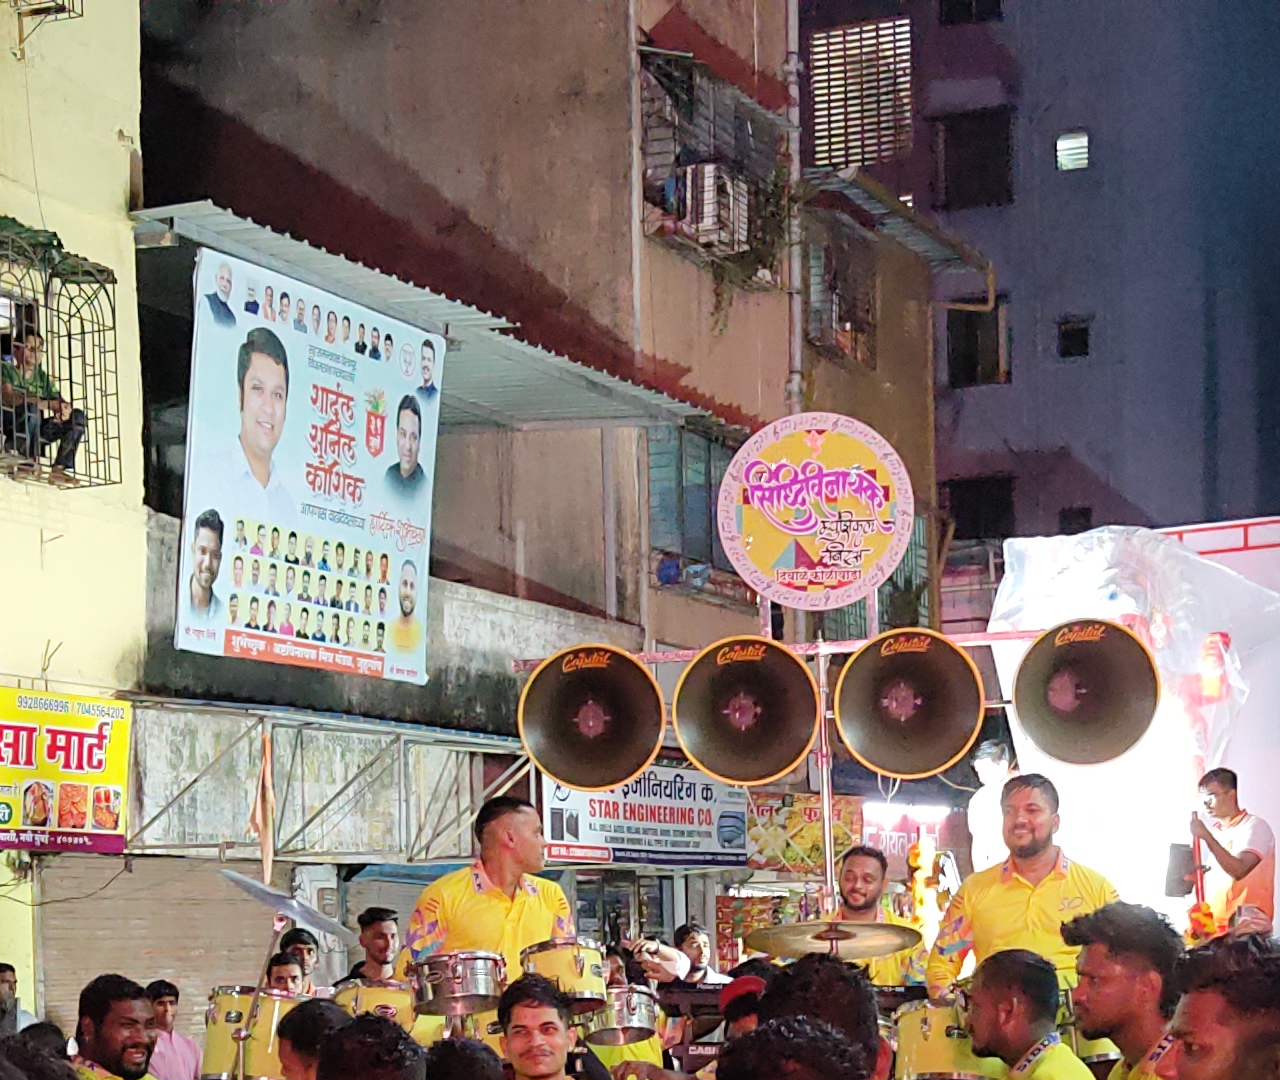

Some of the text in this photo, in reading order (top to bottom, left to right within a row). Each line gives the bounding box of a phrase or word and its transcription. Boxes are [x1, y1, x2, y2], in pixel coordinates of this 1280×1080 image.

[1053, 623, 1107, 647] Capital
[45, 720, 112, 773] मार्ट
[589, 798, 715, 827] STAR ENGINEERING CO.
[688, 1046, 719, 1055] CASI
